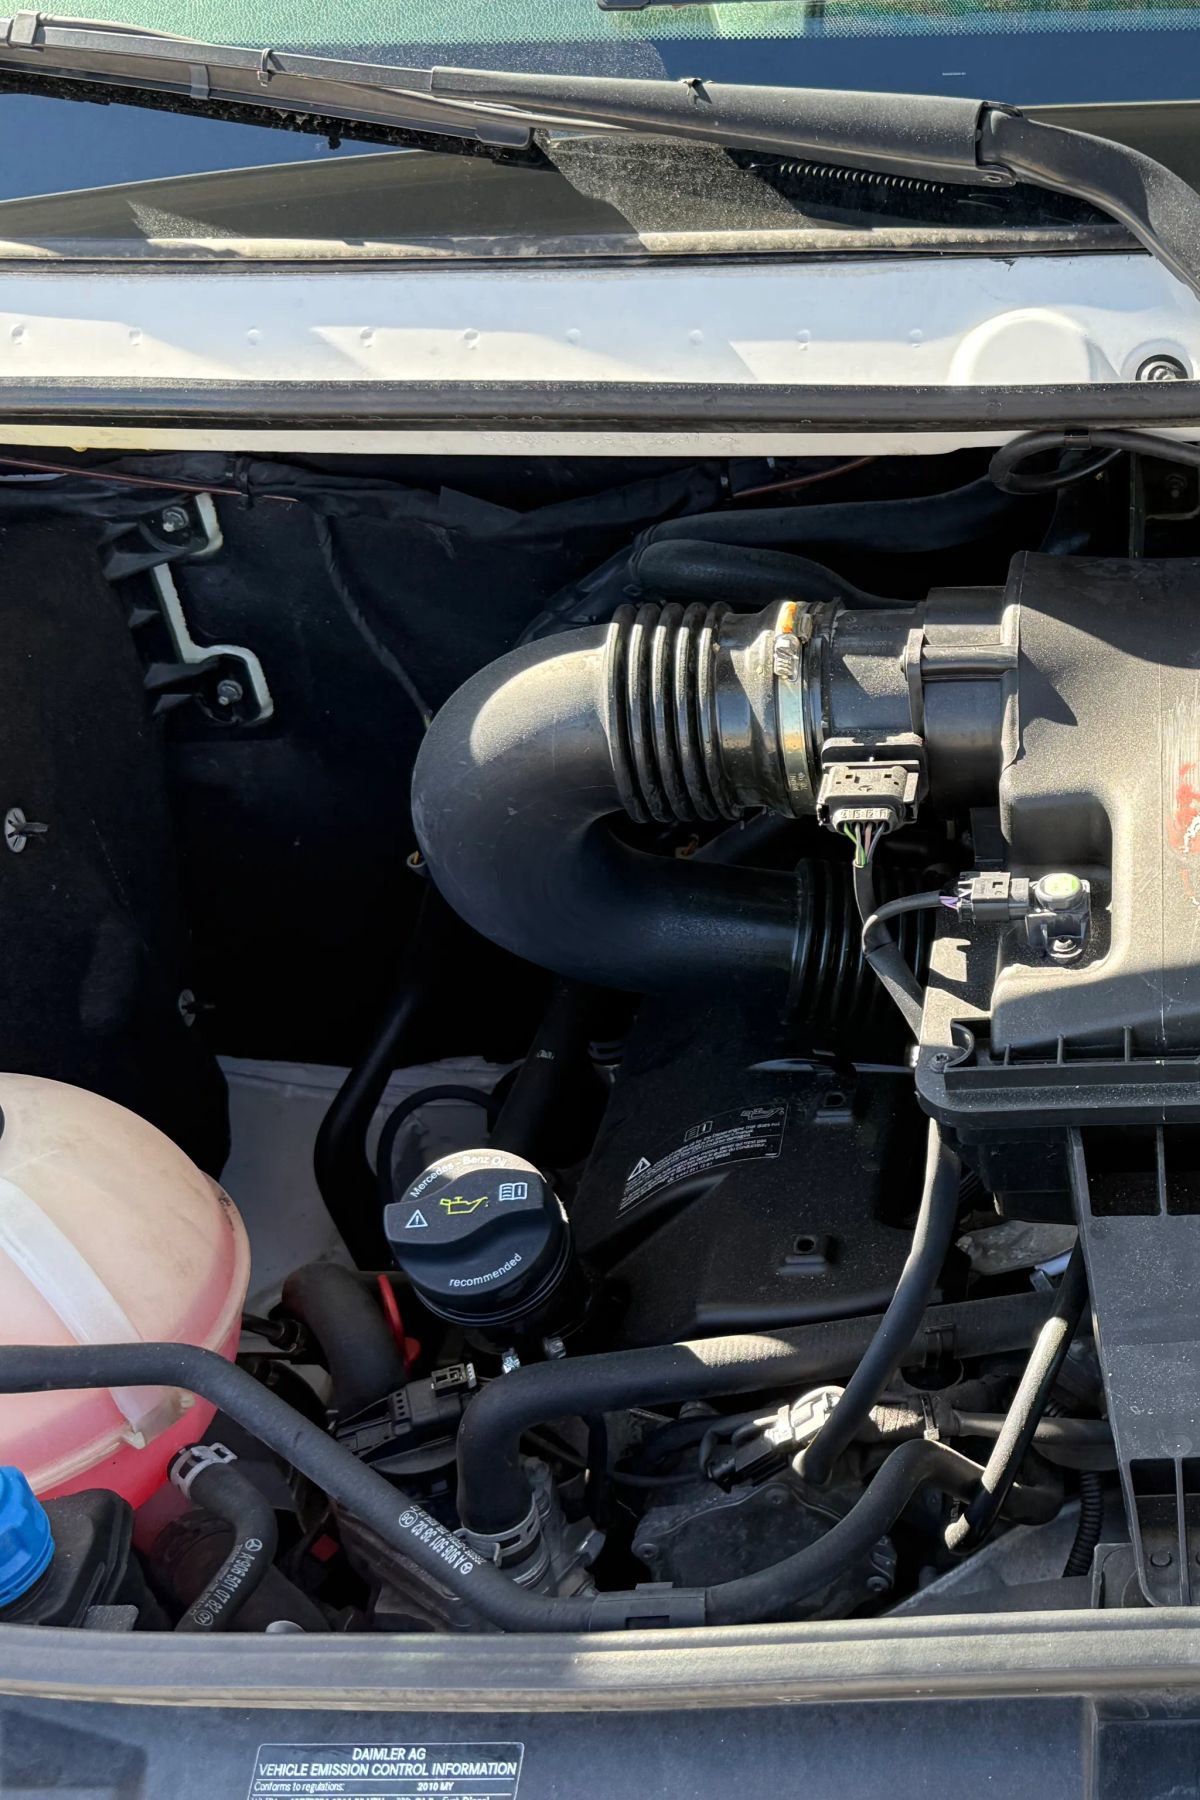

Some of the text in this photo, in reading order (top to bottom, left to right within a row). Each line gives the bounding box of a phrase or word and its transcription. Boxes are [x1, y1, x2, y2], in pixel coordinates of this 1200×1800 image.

[410, 1163, 454, 1198] Mercedes
[463, 1156, 489, 1165] Benz
[491, 1157, 508, 1168] Oil
[449, 1253, 522, 1287] recommended
[428, 1535, 449, 1553] 501
[239, 1551, 255, 1561] A
[440, 1544, 461, 1564] 906
[452, 1554, 468, 1569] A
[231, 1559, 251, 1577] 906
[221, 1574, 242, 1593] 501
[213, 1589, 231, 1604] 07
[204, 1599, 223, 1614] 82
[352, 1748, 427, 1761] DAIMLER AG
[258, 1762, 517, 1776] VEHICLE EMISSION CONTROL INFORMATION
[254, 1782, 454, 1793] Conforms to regulations: 2010 MY
